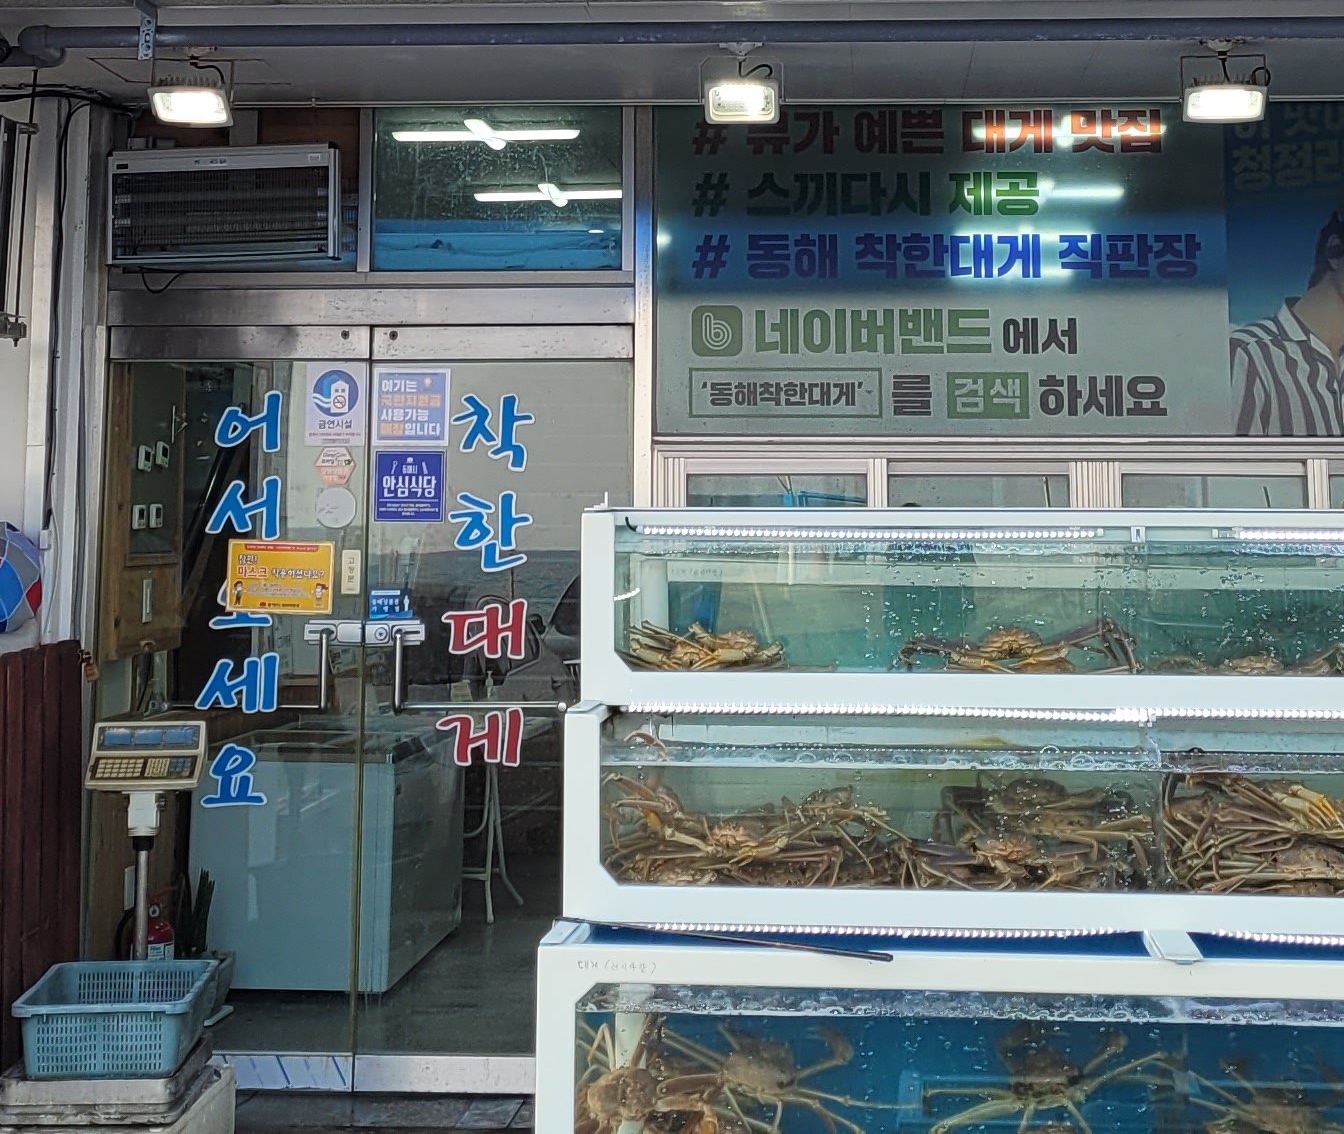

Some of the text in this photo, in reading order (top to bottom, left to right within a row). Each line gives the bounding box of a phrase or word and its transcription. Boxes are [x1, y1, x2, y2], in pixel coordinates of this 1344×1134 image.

[854, 110, 945, 156] 예쁜
[962, 109, 1055, 154] 대게
[1068, 108, 1164, 154] 맛집
[747, 170, 932, 218] 스끼다시
[949, 170, 1041, 217] 제공
[747, 232, 833, 280] 동해
[854, 232, 1043, 280] 착한대게
[1058, 232, 1201, 280] 직판장
[755, 307, 992, 355] 네이버밴드
[1002, 317, 1077, 355] 에서
[381, 379, 417, 392] 여기는
[891, 374, 933, 416] 를
[953, 376, 1022, 414] 검색
[1039, 374, 1168, 418] 하세요
[318, 419, 353, 430] 금연시설
[380, 408, 429, 422] 사용가능
[380, 422, 441, 436] 매장입니다
[382, 475, 437, 498] 안심식당
[237, 566, 268, 579] 마스크
